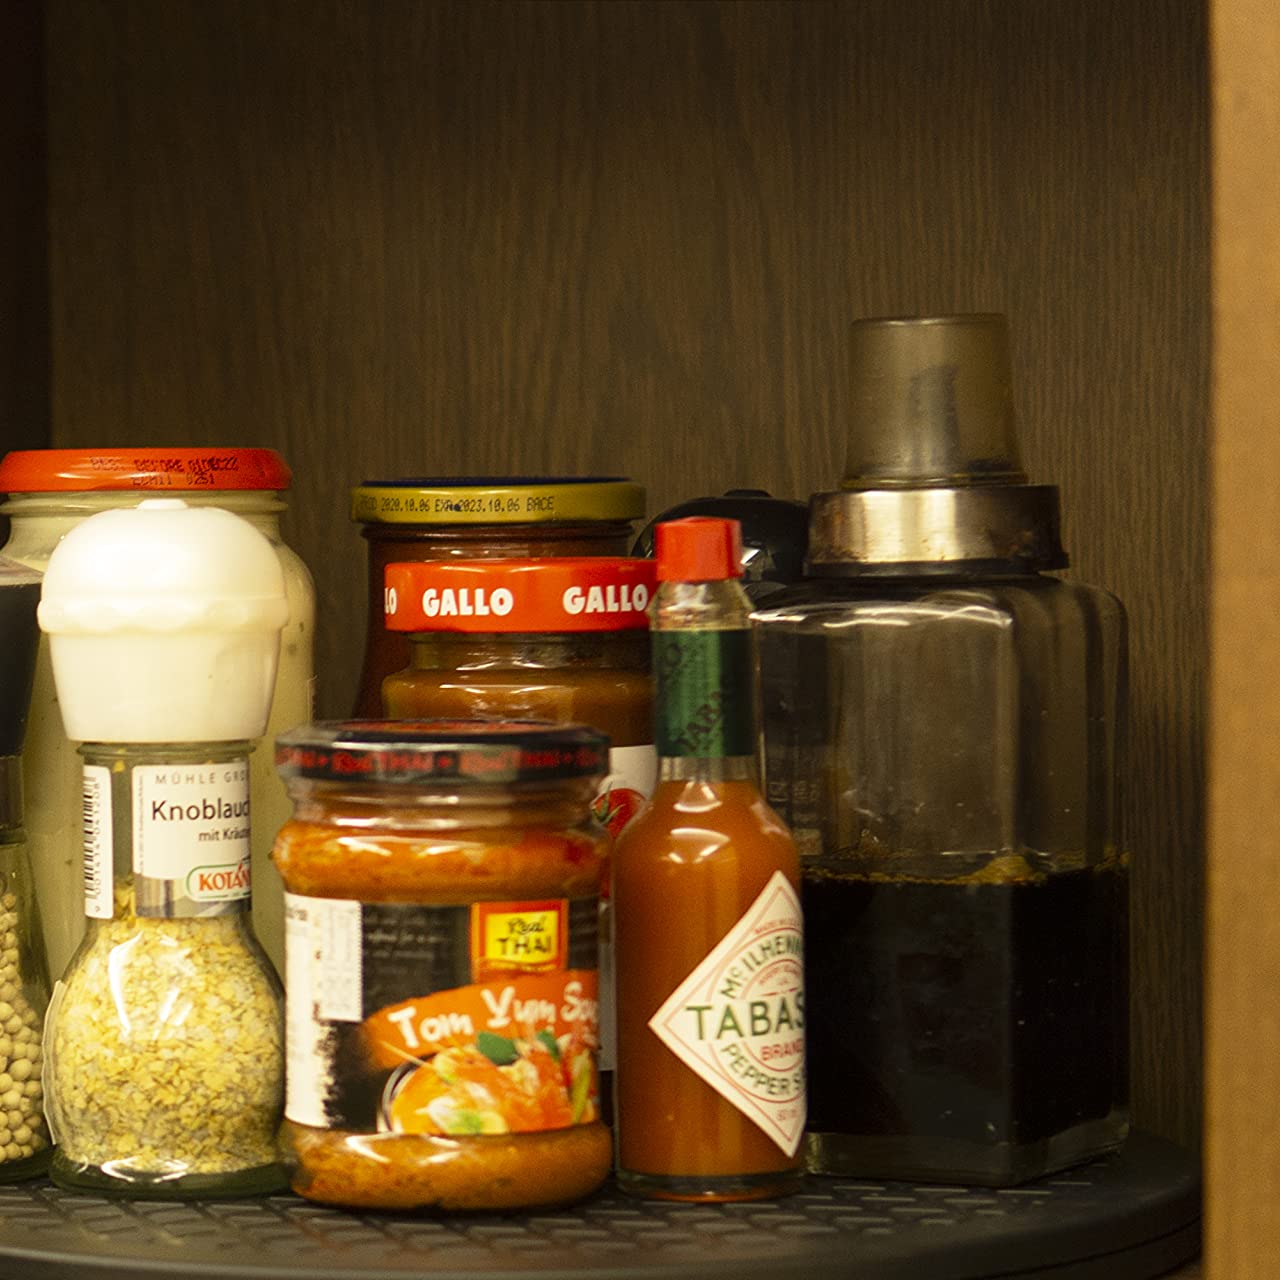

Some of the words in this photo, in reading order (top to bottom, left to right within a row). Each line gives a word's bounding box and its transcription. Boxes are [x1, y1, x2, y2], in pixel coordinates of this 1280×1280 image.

[422, 588, 514, 617] GALLO
[563, 584, 649, 615] GALLO
[198, 828, 220, 841] mit
[497, 936, 552, 956] THAI
[388, 1005, 474, 1050] Tom
[480, 985, 557, 1031] Yum
[720, 1042, 790, 1096] PEPPER
